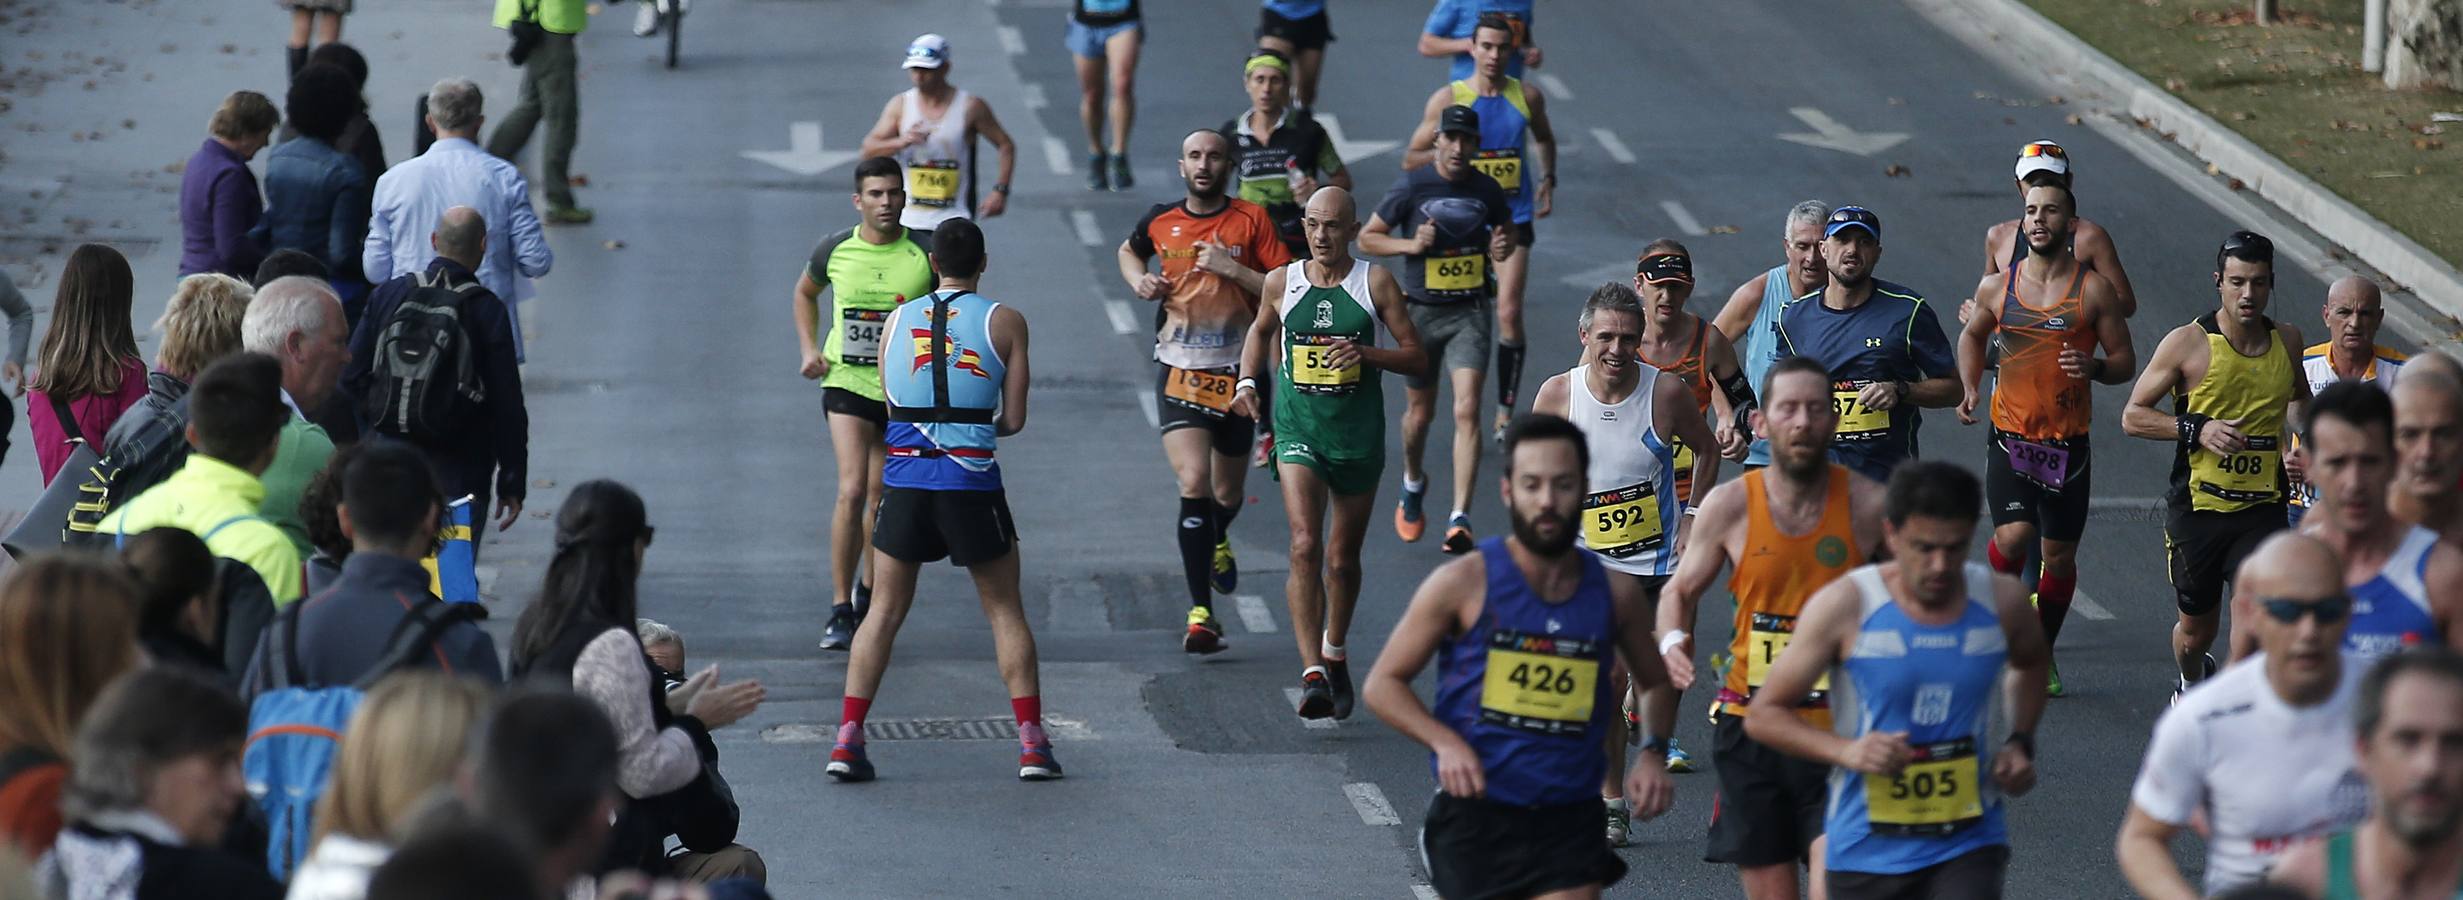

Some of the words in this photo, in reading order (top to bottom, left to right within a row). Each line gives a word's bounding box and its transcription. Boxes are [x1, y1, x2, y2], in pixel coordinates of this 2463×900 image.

[1438, 260, 1475, 276] 662
[1179, 370, 1228, 395] 1628
[2014, 444, 2061, 470] 2298
[2217, 454, 2262, 475] 408
[1598, 505, 1644, 532] 592
[1508, 662, 1575, 695] 426
[1890, 769, 1958, 800] 505
